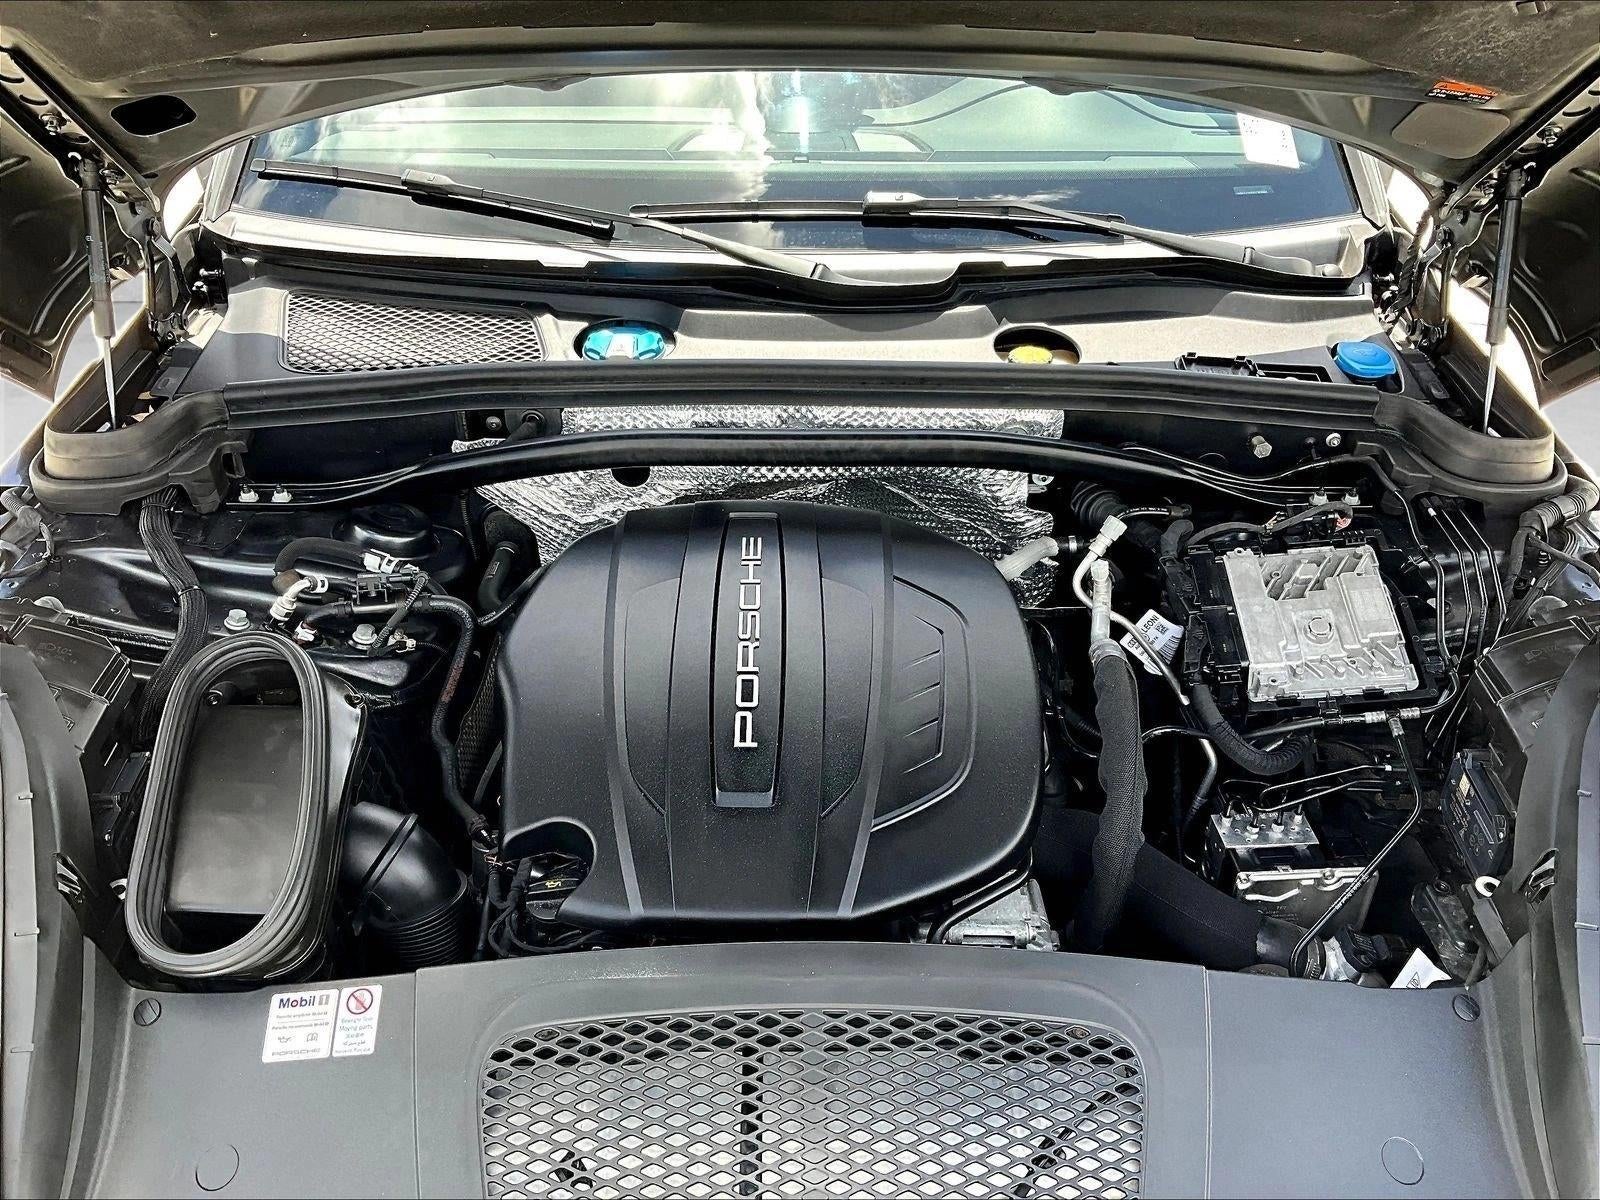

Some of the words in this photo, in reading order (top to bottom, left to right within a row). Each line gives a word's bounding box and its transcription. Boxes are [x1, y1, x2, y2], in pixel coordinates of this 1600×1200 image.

[1141, 614, 1160, 633] LEONI
[733, 536, 762, 748] PORSCHE
[278, 995, 316, 1009] Mobil
